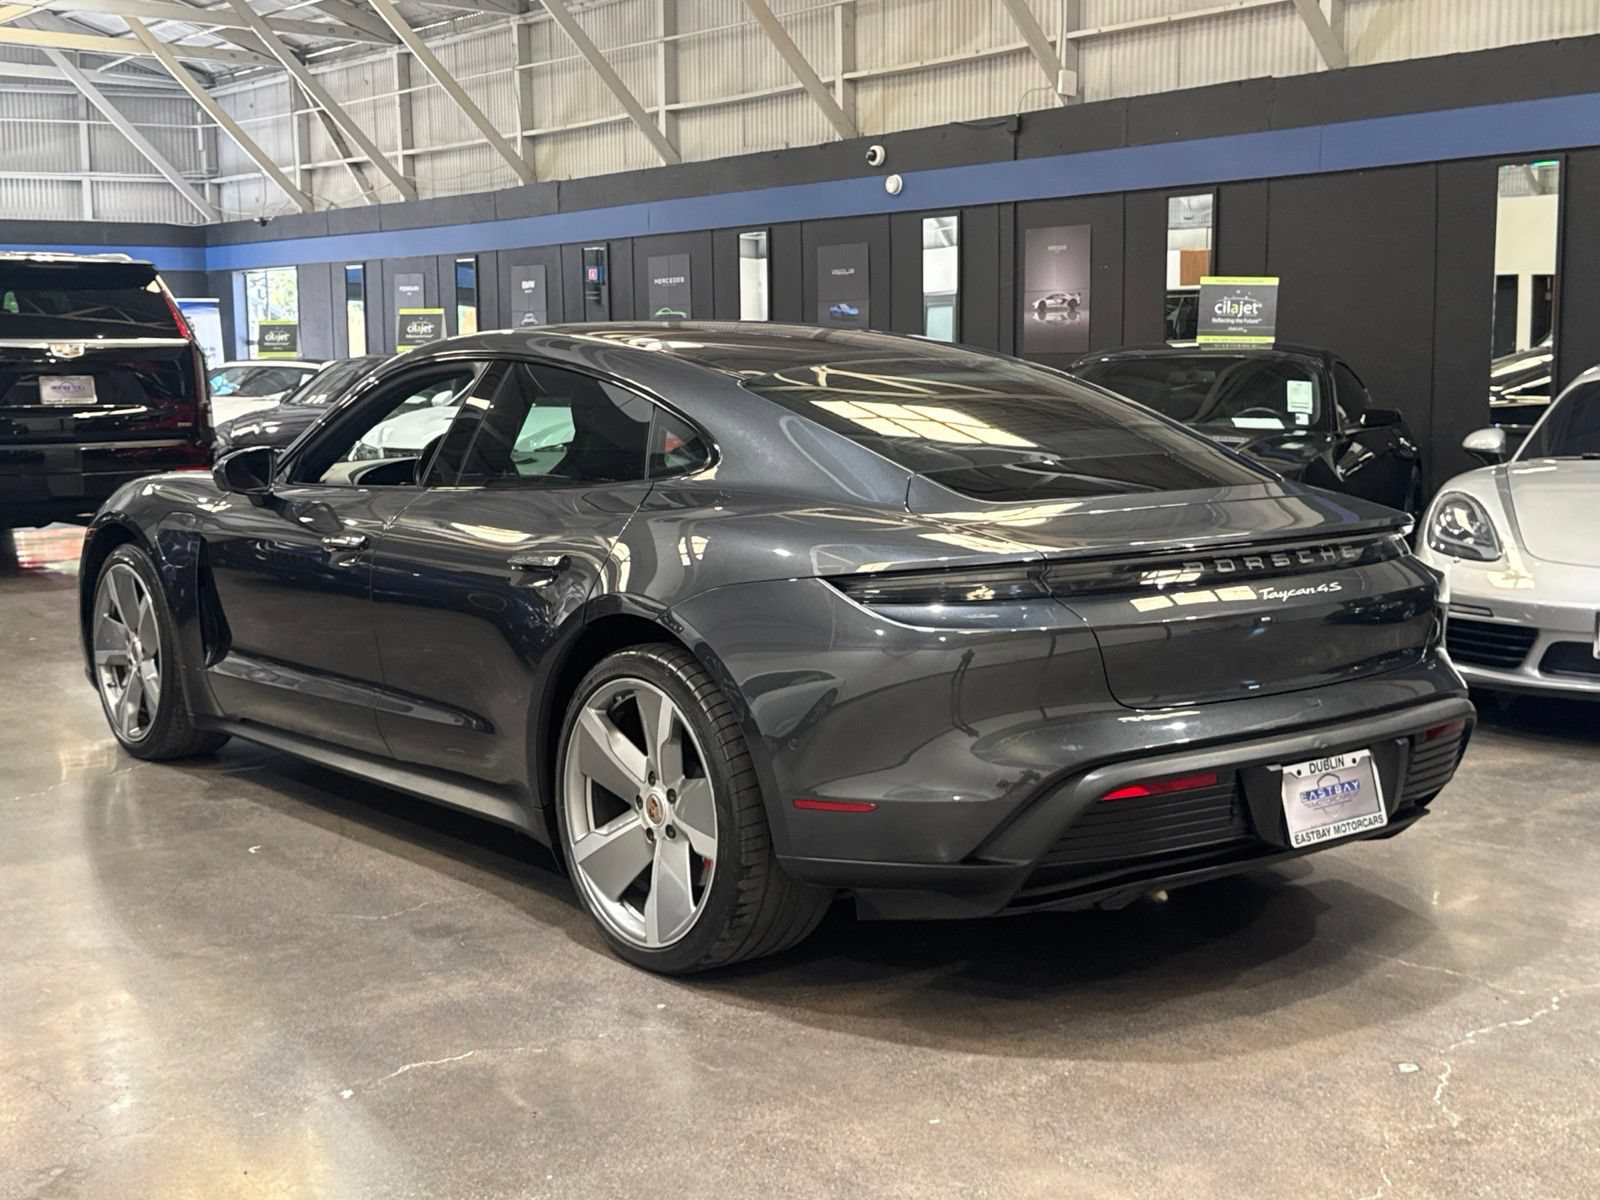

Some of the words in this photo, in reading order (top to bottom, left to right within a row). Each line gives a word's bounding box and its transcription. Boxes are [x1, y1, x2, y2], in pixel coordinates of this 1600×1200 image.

[654, 276, 685, 284] MERCEDES
[1214, 300, 1261, 317] cilajet
[1182, 545, 1356, 573] PORSCHE
[1258, 585, 1315, 602] Taycan
[1308, 756, 1345, 774] DUBLIN
[1300, 781, 1360, 802] EASTBAY
[1294, 828, 1332, 845] EASTBAY
[1333, 814, 1384, 834] MOTORCARS
